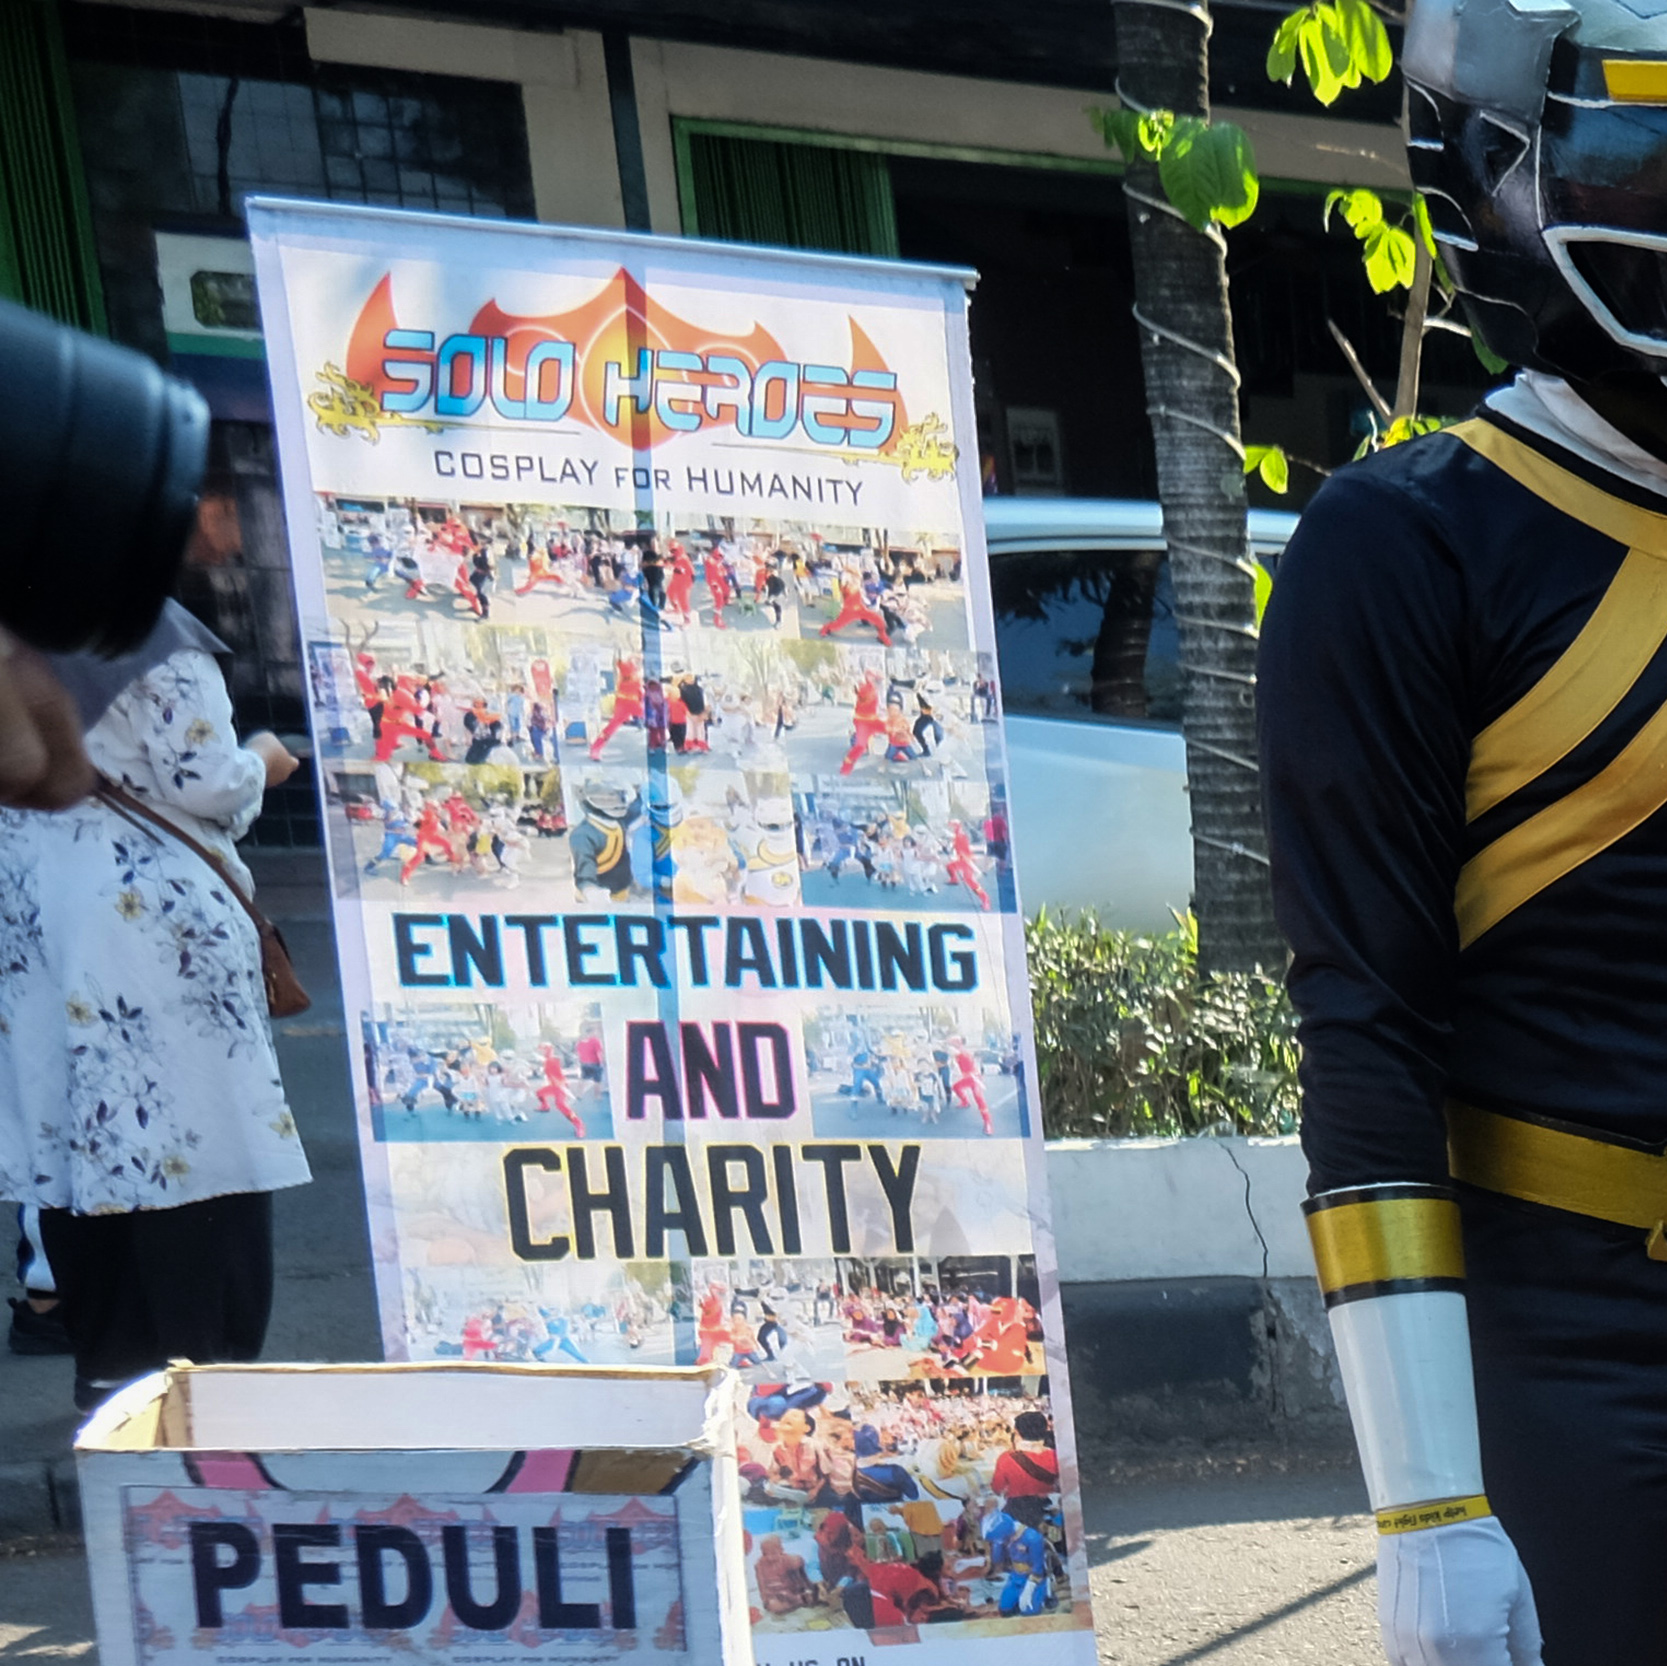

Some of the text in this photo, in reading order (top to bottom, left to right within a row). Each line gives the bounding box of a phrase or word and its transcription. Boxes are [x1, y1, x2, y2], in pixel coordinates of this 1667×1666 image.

[380, 328, 898, 449] SOLO HEROES
[434, 450, 863, 506] COSPLAY FOR HUMANITY
[392, 913, 978, 992] ENTERTAINING
[626, 1021, 798, 1120] AND
[502, 1143, 921, 1261] CHARITY
[189, 1521, 637, 1630] PEDULI
